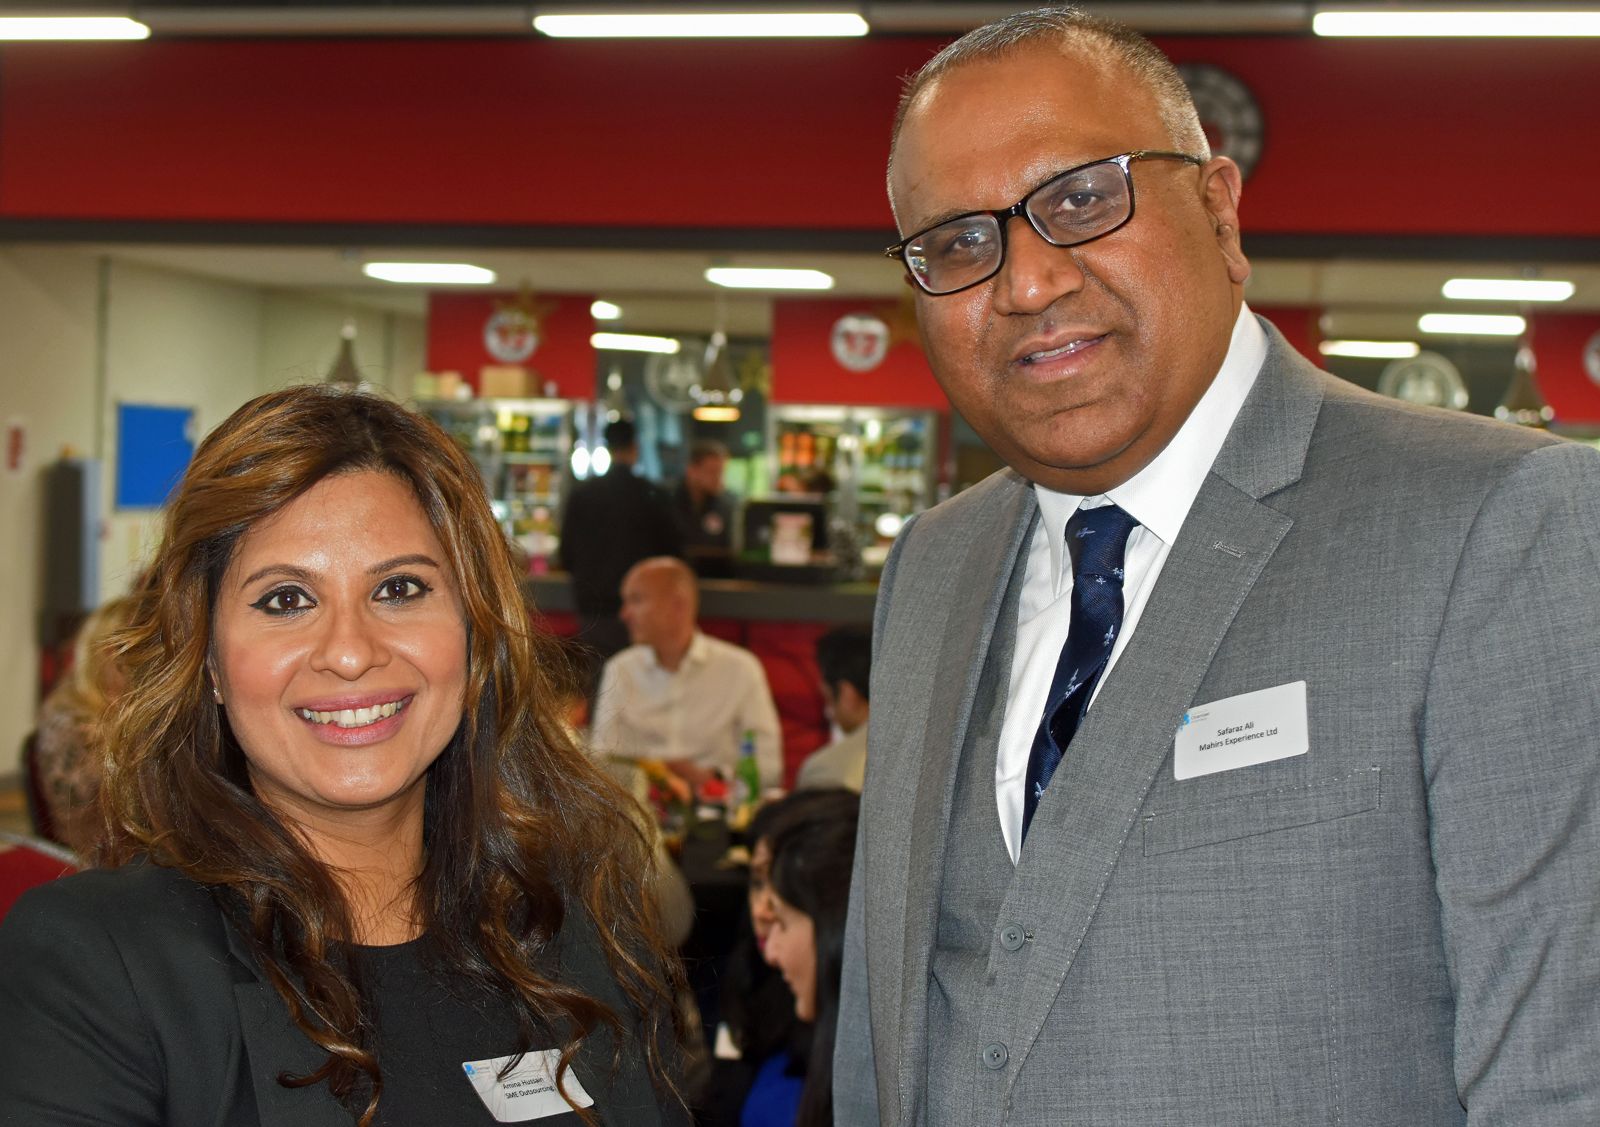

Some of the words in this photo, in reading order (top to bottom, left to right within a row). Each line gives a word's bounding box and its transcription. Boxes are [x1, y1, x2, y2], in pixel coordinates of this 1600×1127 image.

[1217, 725, 1243, 737] Safaraz
[1244, 721, 1255, 730] Ali
[1199, 741, 1224, 751] Mahirs
[1225, 731, 1265, 746] Experience
[1266, 727, 1278, 737] Ltd
[503, 1082, 521, 1090] Amina
[521, 1077, 544, 1086] Hussain
[505, 1090, 519, 1099] SME
[519, 1085, 555, 1097] Outsourcing
